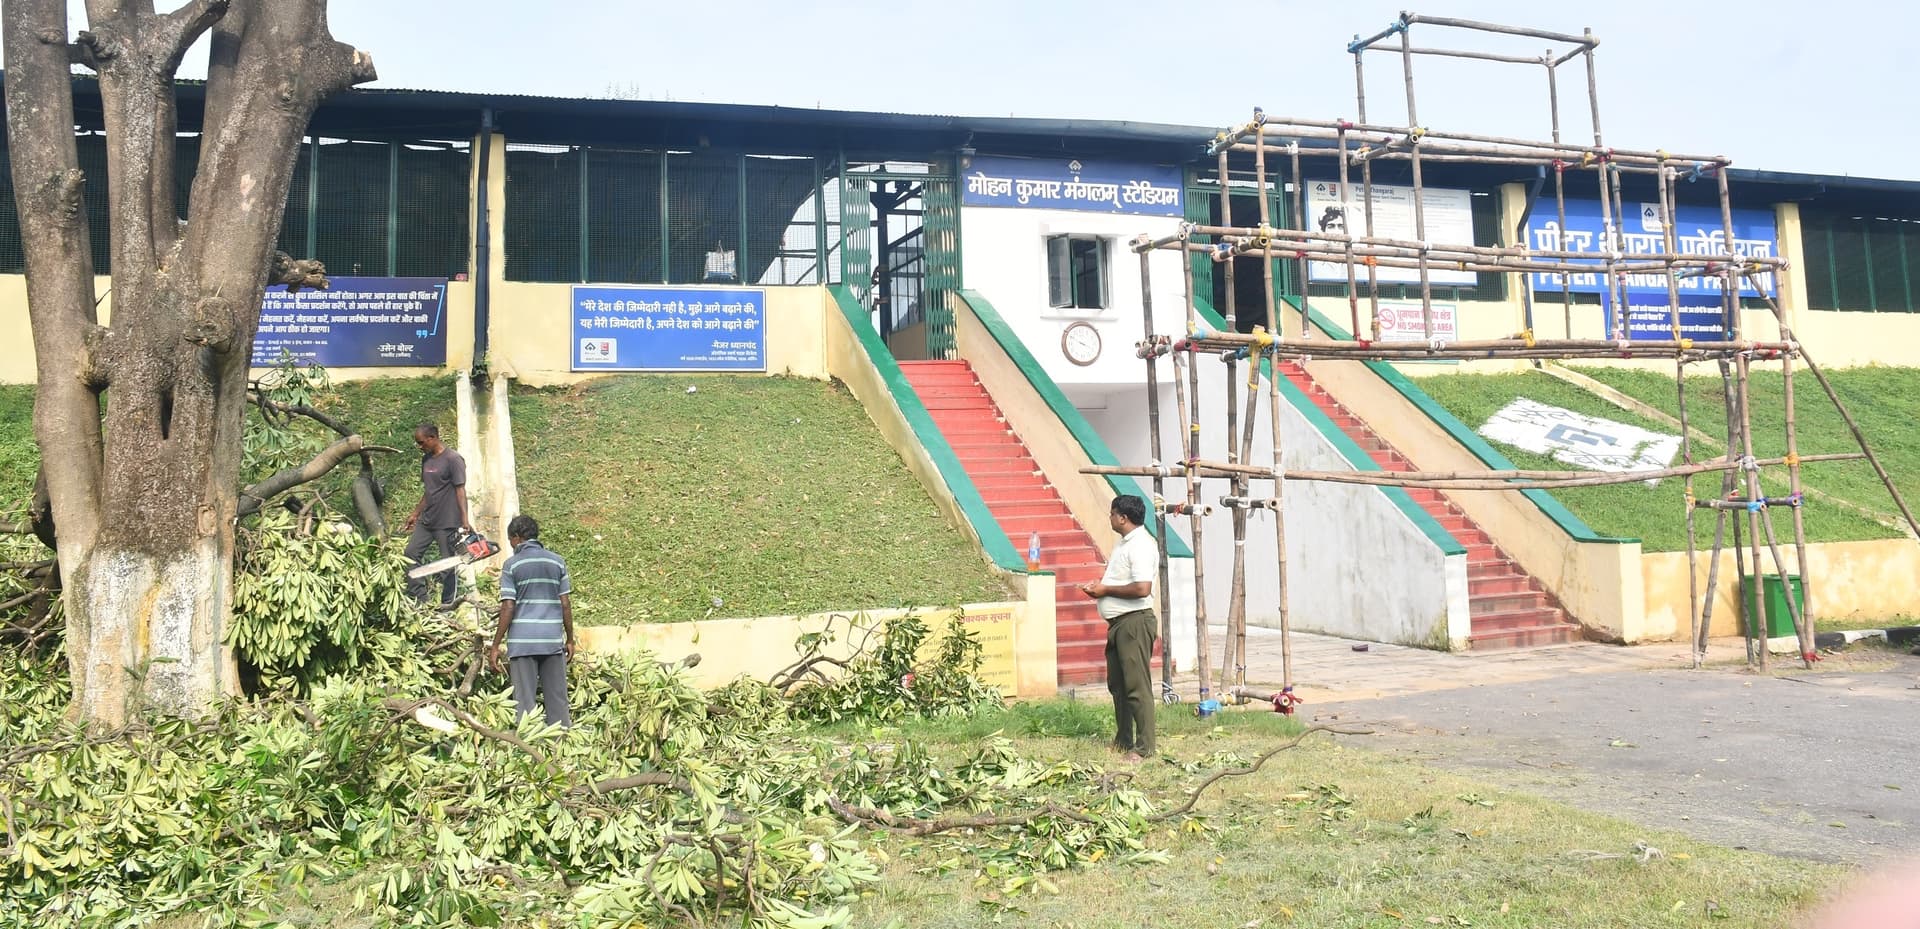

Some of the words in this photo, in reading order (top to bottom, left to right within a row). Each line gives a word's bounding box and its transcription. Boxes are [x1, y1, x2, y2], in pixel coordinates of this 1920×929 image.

[967, 172, 1012, 196] मोहन
[1015, 179, 1062, 204] कुमार
[1064, 176, 1122, 208] मंगलम्
[1122, 181, 1179, 206] स्टेडियम
[1539, 269, 1596, 286] PETER
[598, 299, 611, 312] देश
[613, 300, 625, 312] की
[626, 300, 661, 312] जिम्मेदारी
[688, 301, 702, 315] मुझे
[703, 301, 720, 313] आगे
[722, 301, 742, 315] बढ़ाने
[579, 318, 592, 329] यह
[593, 317, 608, 329] मेरी
[609, 317, 644, 329] जिम्मेदारी
[655, 317, 675, 329] अपने
[676, 317, 690, 329] देश
[691, 317, 702, 329] को
[703, 318, 720, 330] आगे
[722, 318, 742, 331] बढ़ाने
[1397, 321, 1407, 330] NO
[1437, 323, 1454, 332] AREA
[989, 612, 1011, 624] सूचना
